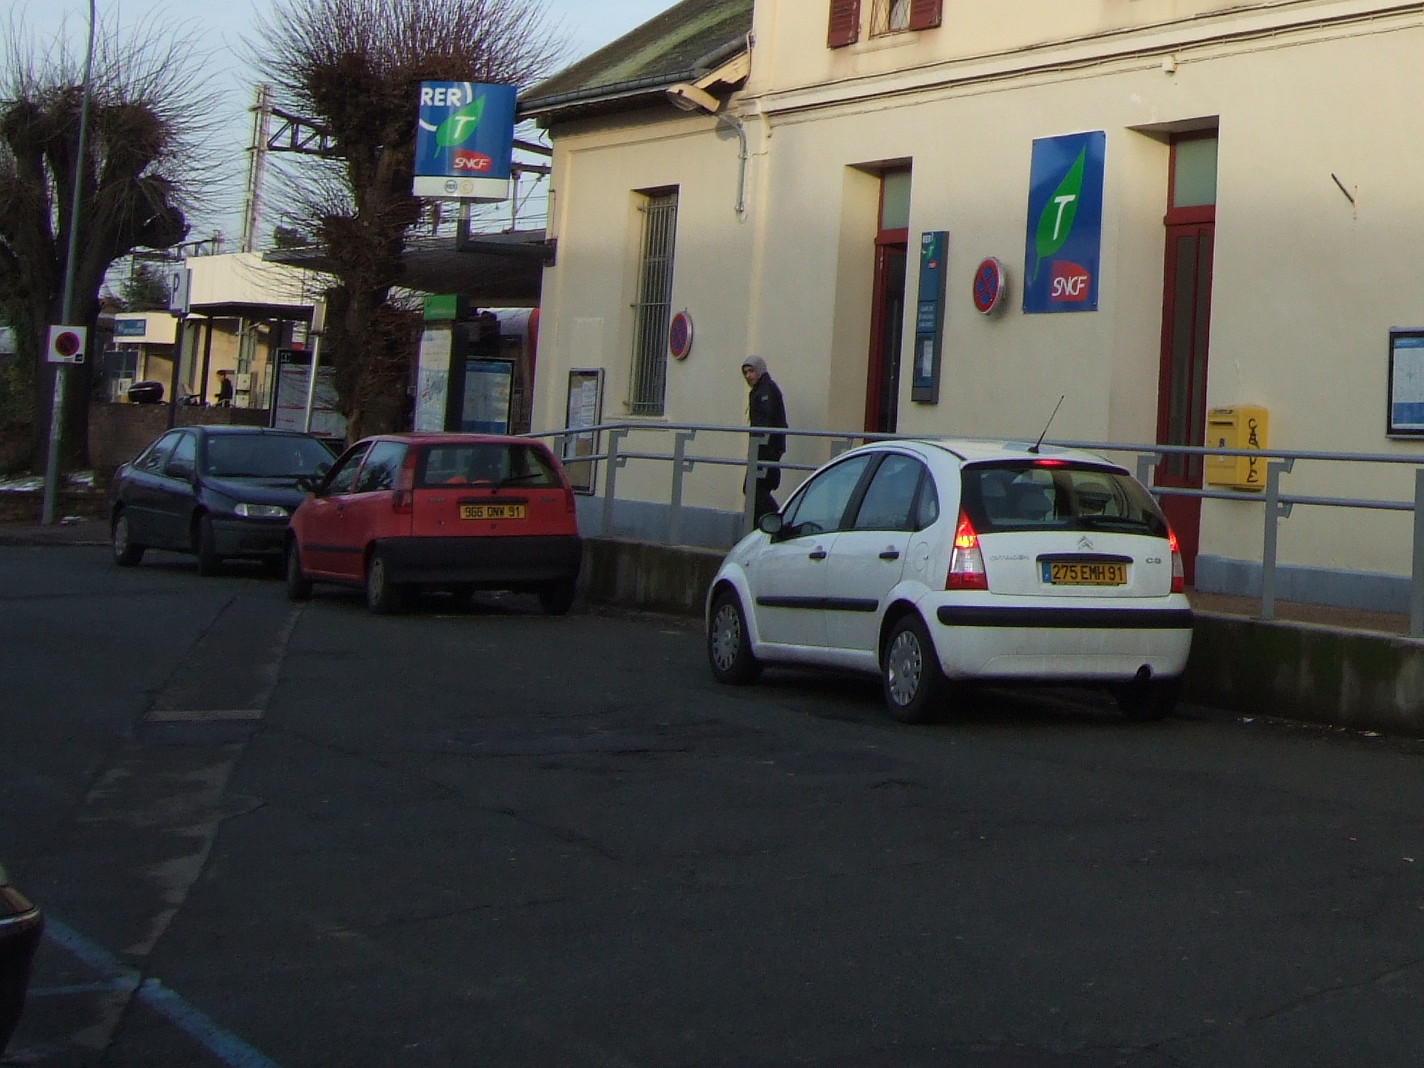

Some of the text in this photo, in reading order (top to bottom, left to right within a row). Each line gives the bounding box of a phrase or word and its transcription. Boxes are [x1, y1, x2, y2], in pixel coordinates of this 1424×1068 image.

[421, 87, 461, 107] RER
[455, 116, 476, 139] T
[453, 157, 490, 169] SNCF
[1053, 195, 1076, 241] T
[172, 272, 180, 304] P
[1051, 275, 1088, 296] SNCF
[1052, 564, 1124, 581] 275 EMH 91
